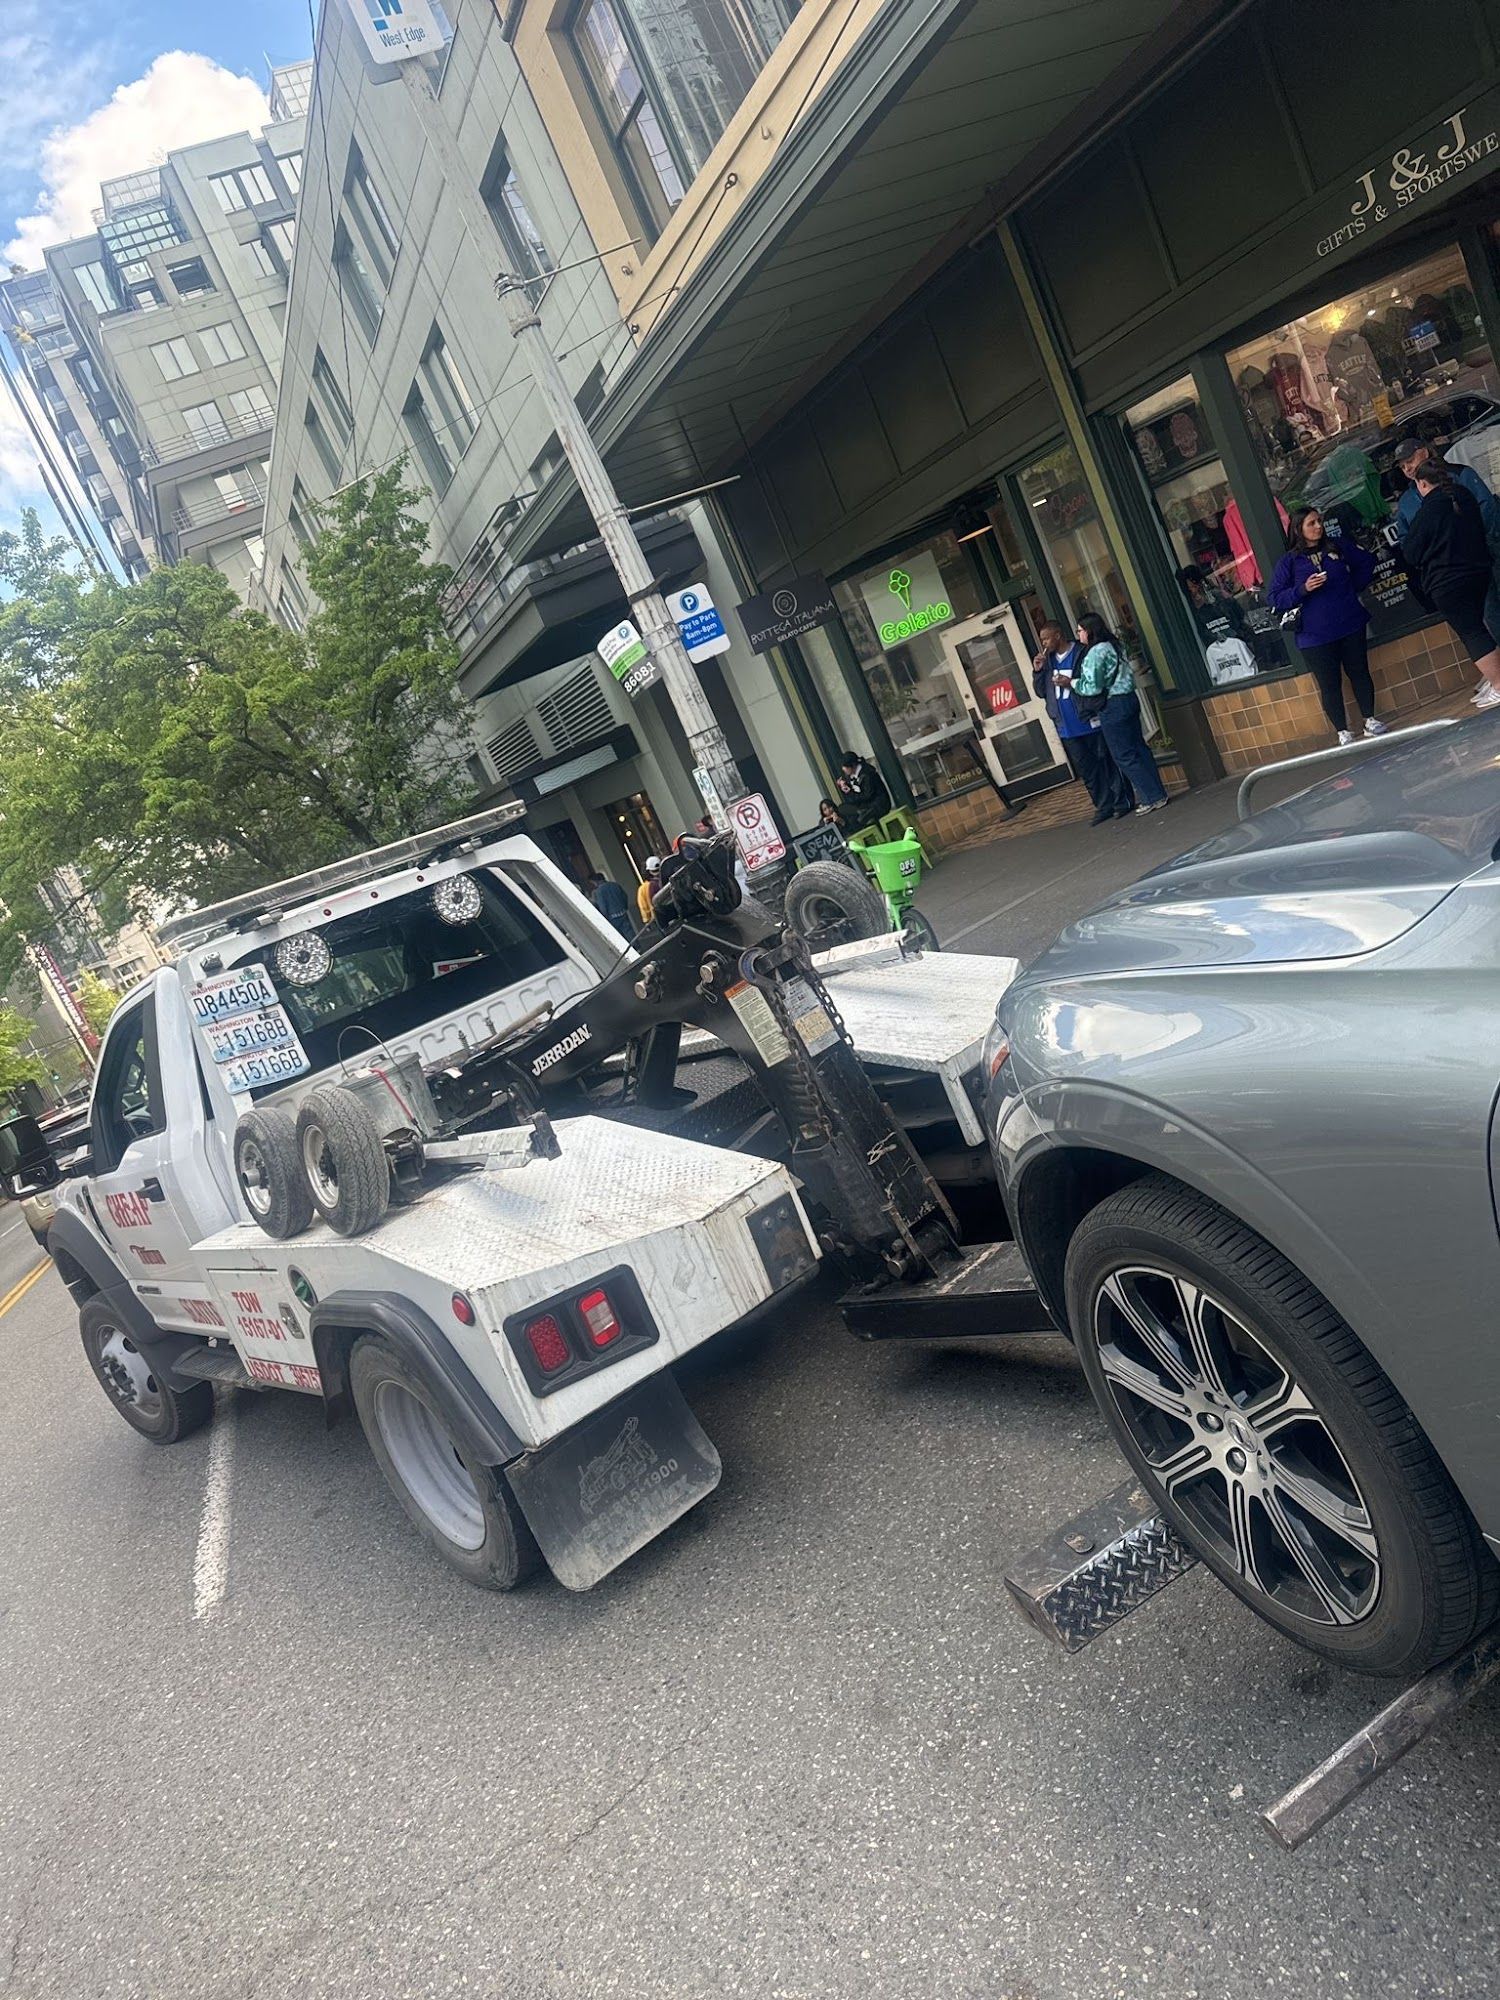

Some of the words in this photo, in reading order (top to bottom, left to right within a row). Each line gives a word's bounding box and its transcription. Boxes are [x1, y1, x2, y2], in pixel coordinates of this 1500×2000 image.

[380, 31, 405, 48] West
[404, 27, 426, 43] Edge
[1351, 168, 1376, 216] J
[1389, 148, 1430, 191] &
[1437, 108, 1466, 160] J
[1316, 217, 1366, 257] GIFTS
[1375, 204, 1389, 222] &
[1396, 132, 1500, 209] SPORTSWE
[1369, 572, 1409, 594] LIVER
[1380, 570, 1392, 579] UP
[1384, 593, 1405, 608] FINE
[679, 623, 692, 632] Pay
[692, 619, 700, 627] to
[699, 611, 716, 623] Park
[685, 622, 718, 640] 8am-8pm
[751, 619, 792, 645] BOTTEGA
[794, 600, 835, 624] ITALIANA
[880, 602, 950, 644] Gelato
[624, 661, 656, 693] 86081
[992, 686, 1012, 707] illy
[190, 980, 236, 997] WASHINGTON
[193, 980, 271, 1017] D84450A
[208, 1016, 255, 1034] WASHINGTON
[224, 1018, 288, 1051] 15168B
[237, 1049, 303, 1082] 15166B
[105, 1191, 152, 1228] CHEAP
[232, 1292, 263, 1313] TOW
[245, 1360, 285, 1383] USDOT
